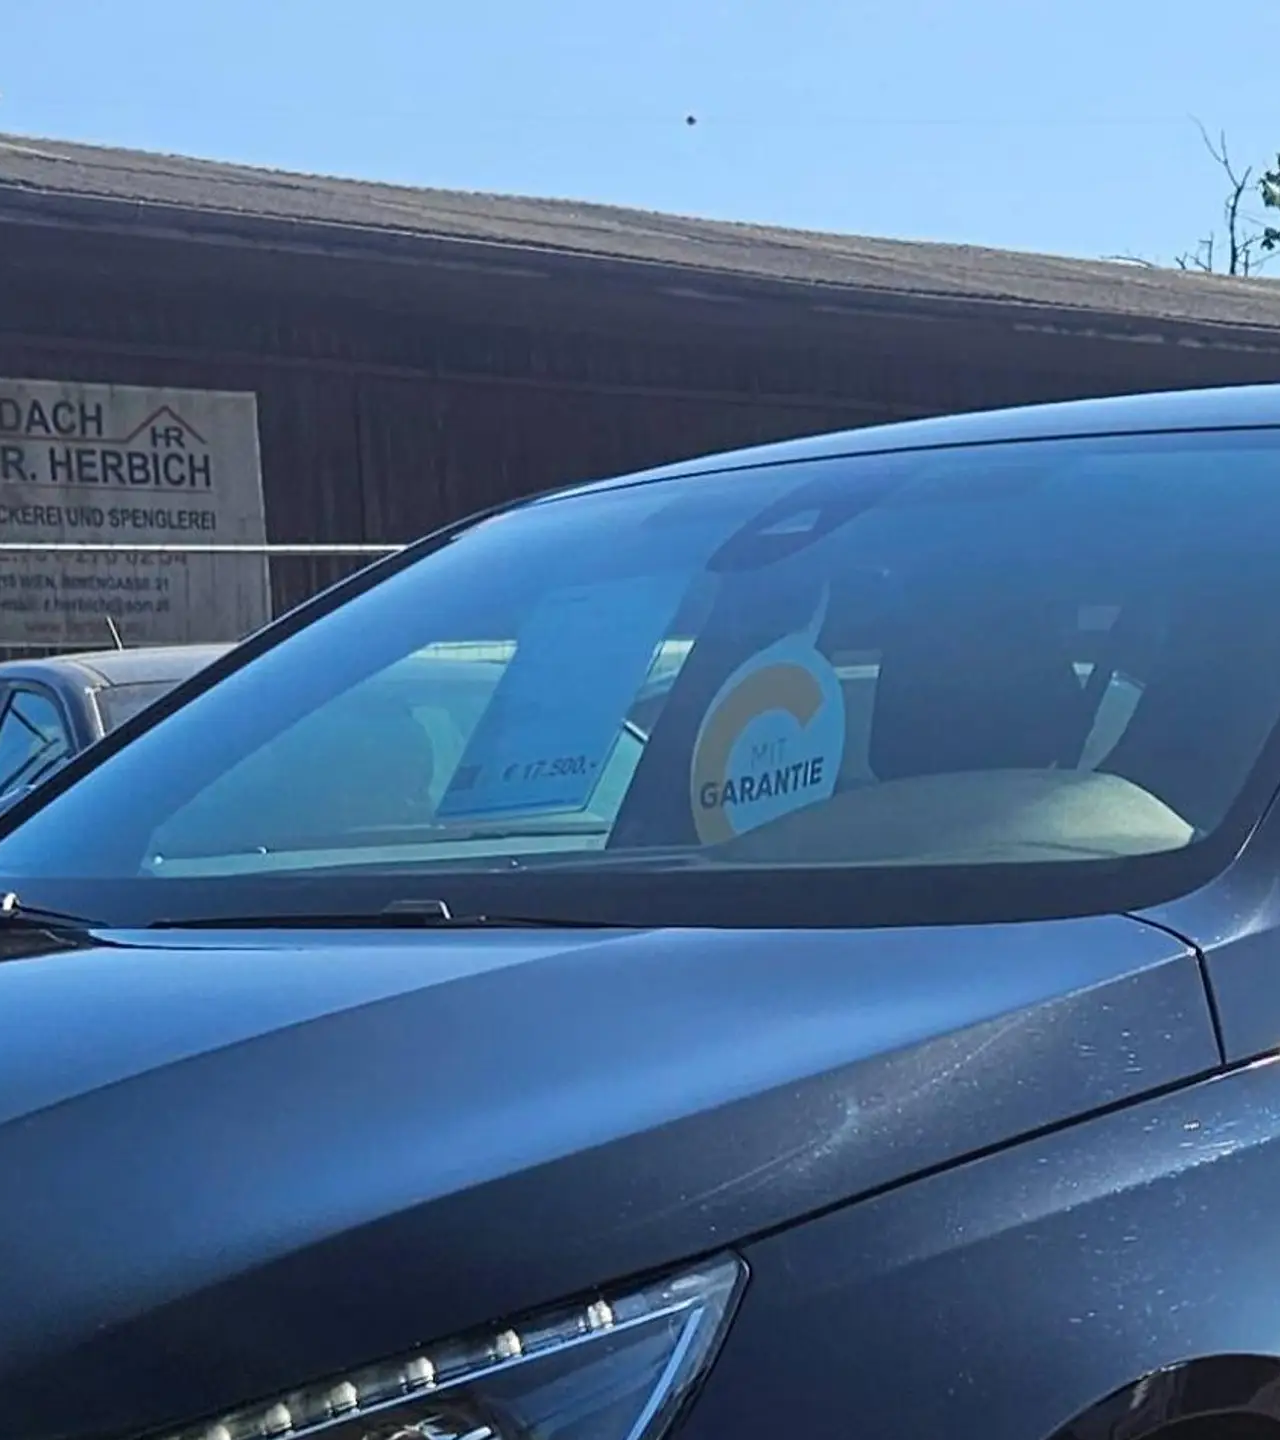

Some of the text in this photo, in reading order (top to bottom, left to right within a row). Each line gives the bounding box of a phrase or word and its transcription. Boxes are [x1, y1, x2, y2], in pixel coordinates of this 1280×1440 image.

[151, 426, 186, 449] HR
[1, 445, 211, 487] R. HERBICH
[69, 508, 104, 528] UND
[108, 510, 216, 530] SPENGLEREI
[751, 736, 788, 768] MIT
[699, 755, 824, 811] GARANTIE
